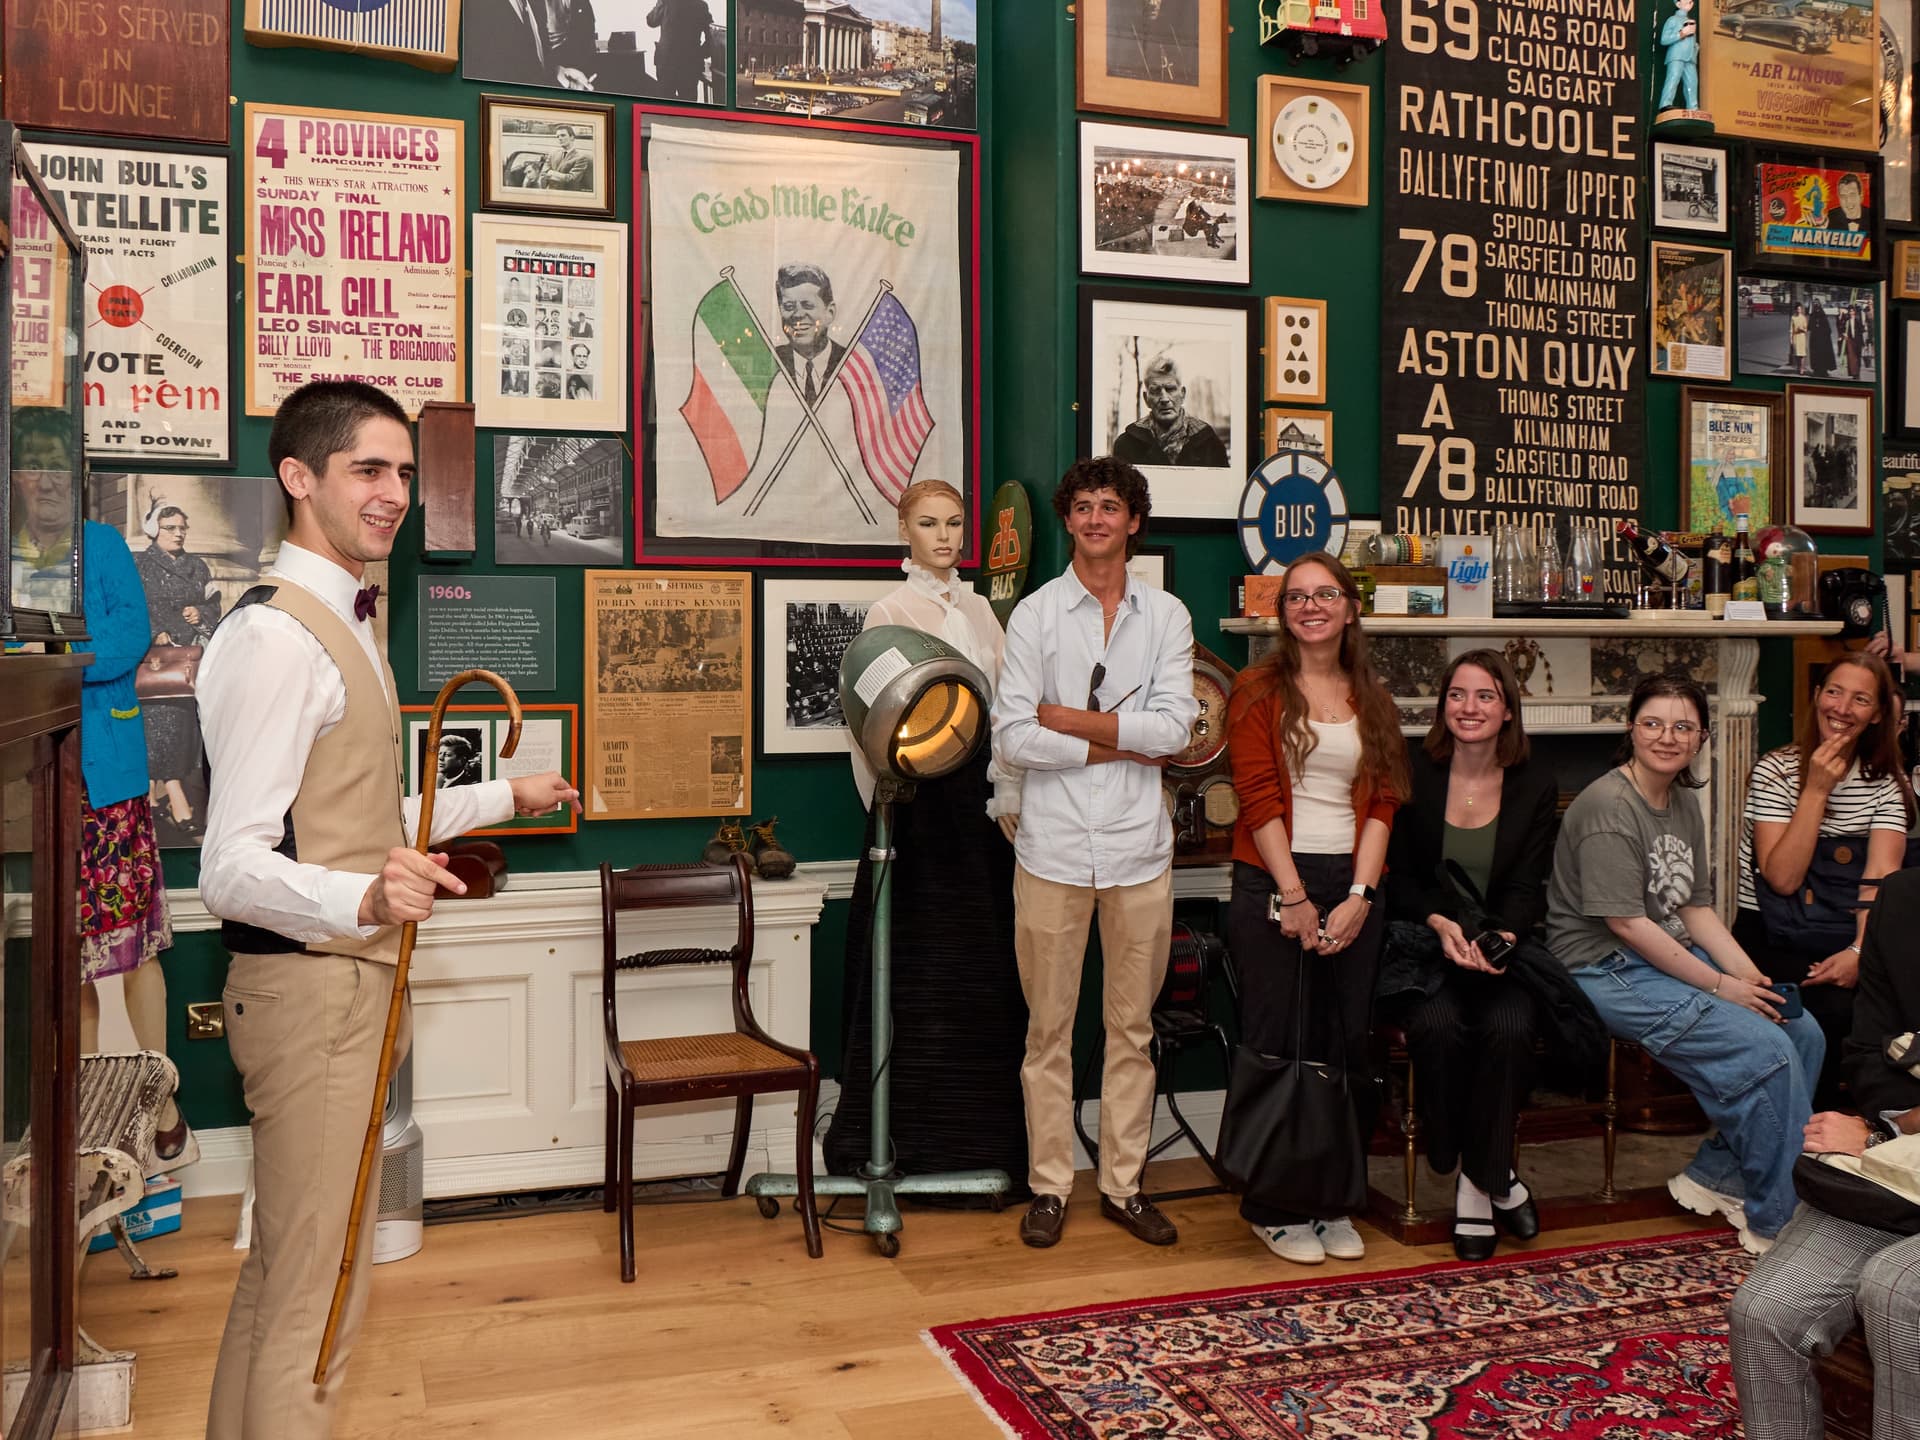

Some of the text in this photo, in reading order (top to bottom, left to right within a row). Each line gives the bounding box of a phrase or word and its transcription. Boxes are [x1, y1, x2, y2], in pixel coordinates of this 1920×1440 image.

[13, 0, 221, 47] LADIES SERVED
[1400, 0, 1480, 61] 69
[1497, 7, 1627, 51] NAAS ROAD
[102, 48, 133, 72] IN
[1487, 35, 1637, 81] CLONDALKIN
[1749, 62, 1783, 80] AER
[1787, 64, 1845, 86] LINGUS
[57, 76, 178, 121] LOUNGE.
[1507, 68, 1616, 107] SAGGART
[1757, 90, 1834, 117] VISCOUNT
[1399, 84, 1636, 161] RATHCOOLE
[256, 118, 440, 169] 4 PROVINCES
[37, 154, 208, 191] JOHN BULL'S
[310, 157, 385, 168] HARCOURT
[391, 162, 442, 172] STREET
[257, 188, 382, 205] SUNDAY FINAL
[283, 175, 429, 193] THIS WEEK'S STAR ATTRACTIONS
[1399, 147, 1636, 221] BALLYFERMOT UPPER
[119, 236, 132, 245] IN
[140, 237, 177, 248] FLIGHT
[260, 204, 451, 264] MISS IRELAND
[1493, 212, 1628, 253] SPIDDAL PARK
[1791, 228, 1865, 248] MARVELLO
[123, 248, 156, 258] FACTS
[257, 257, 288, 269] Dancing
[505, 257, 594, 276] SIXTIES
[1398, 227, 1479, 299] 78
[1484, 241, 1637, 282] SARSFIELD ROAD
[160, 256, 218, 288] COLLABORATION
[403, 266, 440, 276] Admission
[257, 272, 400, 319] EARL GILL
[1504, 272, 1617, 310] KILMAINHAM
[257, 317, 424, 339] LEO SINGLETON
[1485, 300, 1637, 341] THOMAS STREET
[156, 332, 204, 370] COERCION
[257, 334, 290, 357] BILLY
[295, 335, 332, 359] LLOYD
[361, 338, 384, 360] THE
[1396, 326, 1529, 382] ASTON
[1543, 339, 1637, 392] QUAY
[272, 371, 304, 384] THE
[404, 376, 444, 388] CLUB
[1420, 382, 1456, 430] A
[1497, 387, 1625, 424] THOMAS STREET
[101, 420, 142, 430] AND
[105, 433, 213, 449] IT DOWN!
[1513, 418, 1610, 451] KILMAINHAM
[1708, 420, 1753, 434] BLUE NUN
[1395, 433, 1477, 502] 78
[1494, 447, 1630, 482] SARSFIELD ROAD
[1485, 476, 1639, 512] BALLYFERMOT ROAD
[1274, 504, 1317, 539] BUS
[679, 582, 704, 591] TIMES
[990, 573, 1016, 602] BUS
[1448, 559, 1490, 584] Light
[428, 585, 472, 600] 1960s
[596, 599, 742, 608] DUBLIN GREETS KENNEDY
